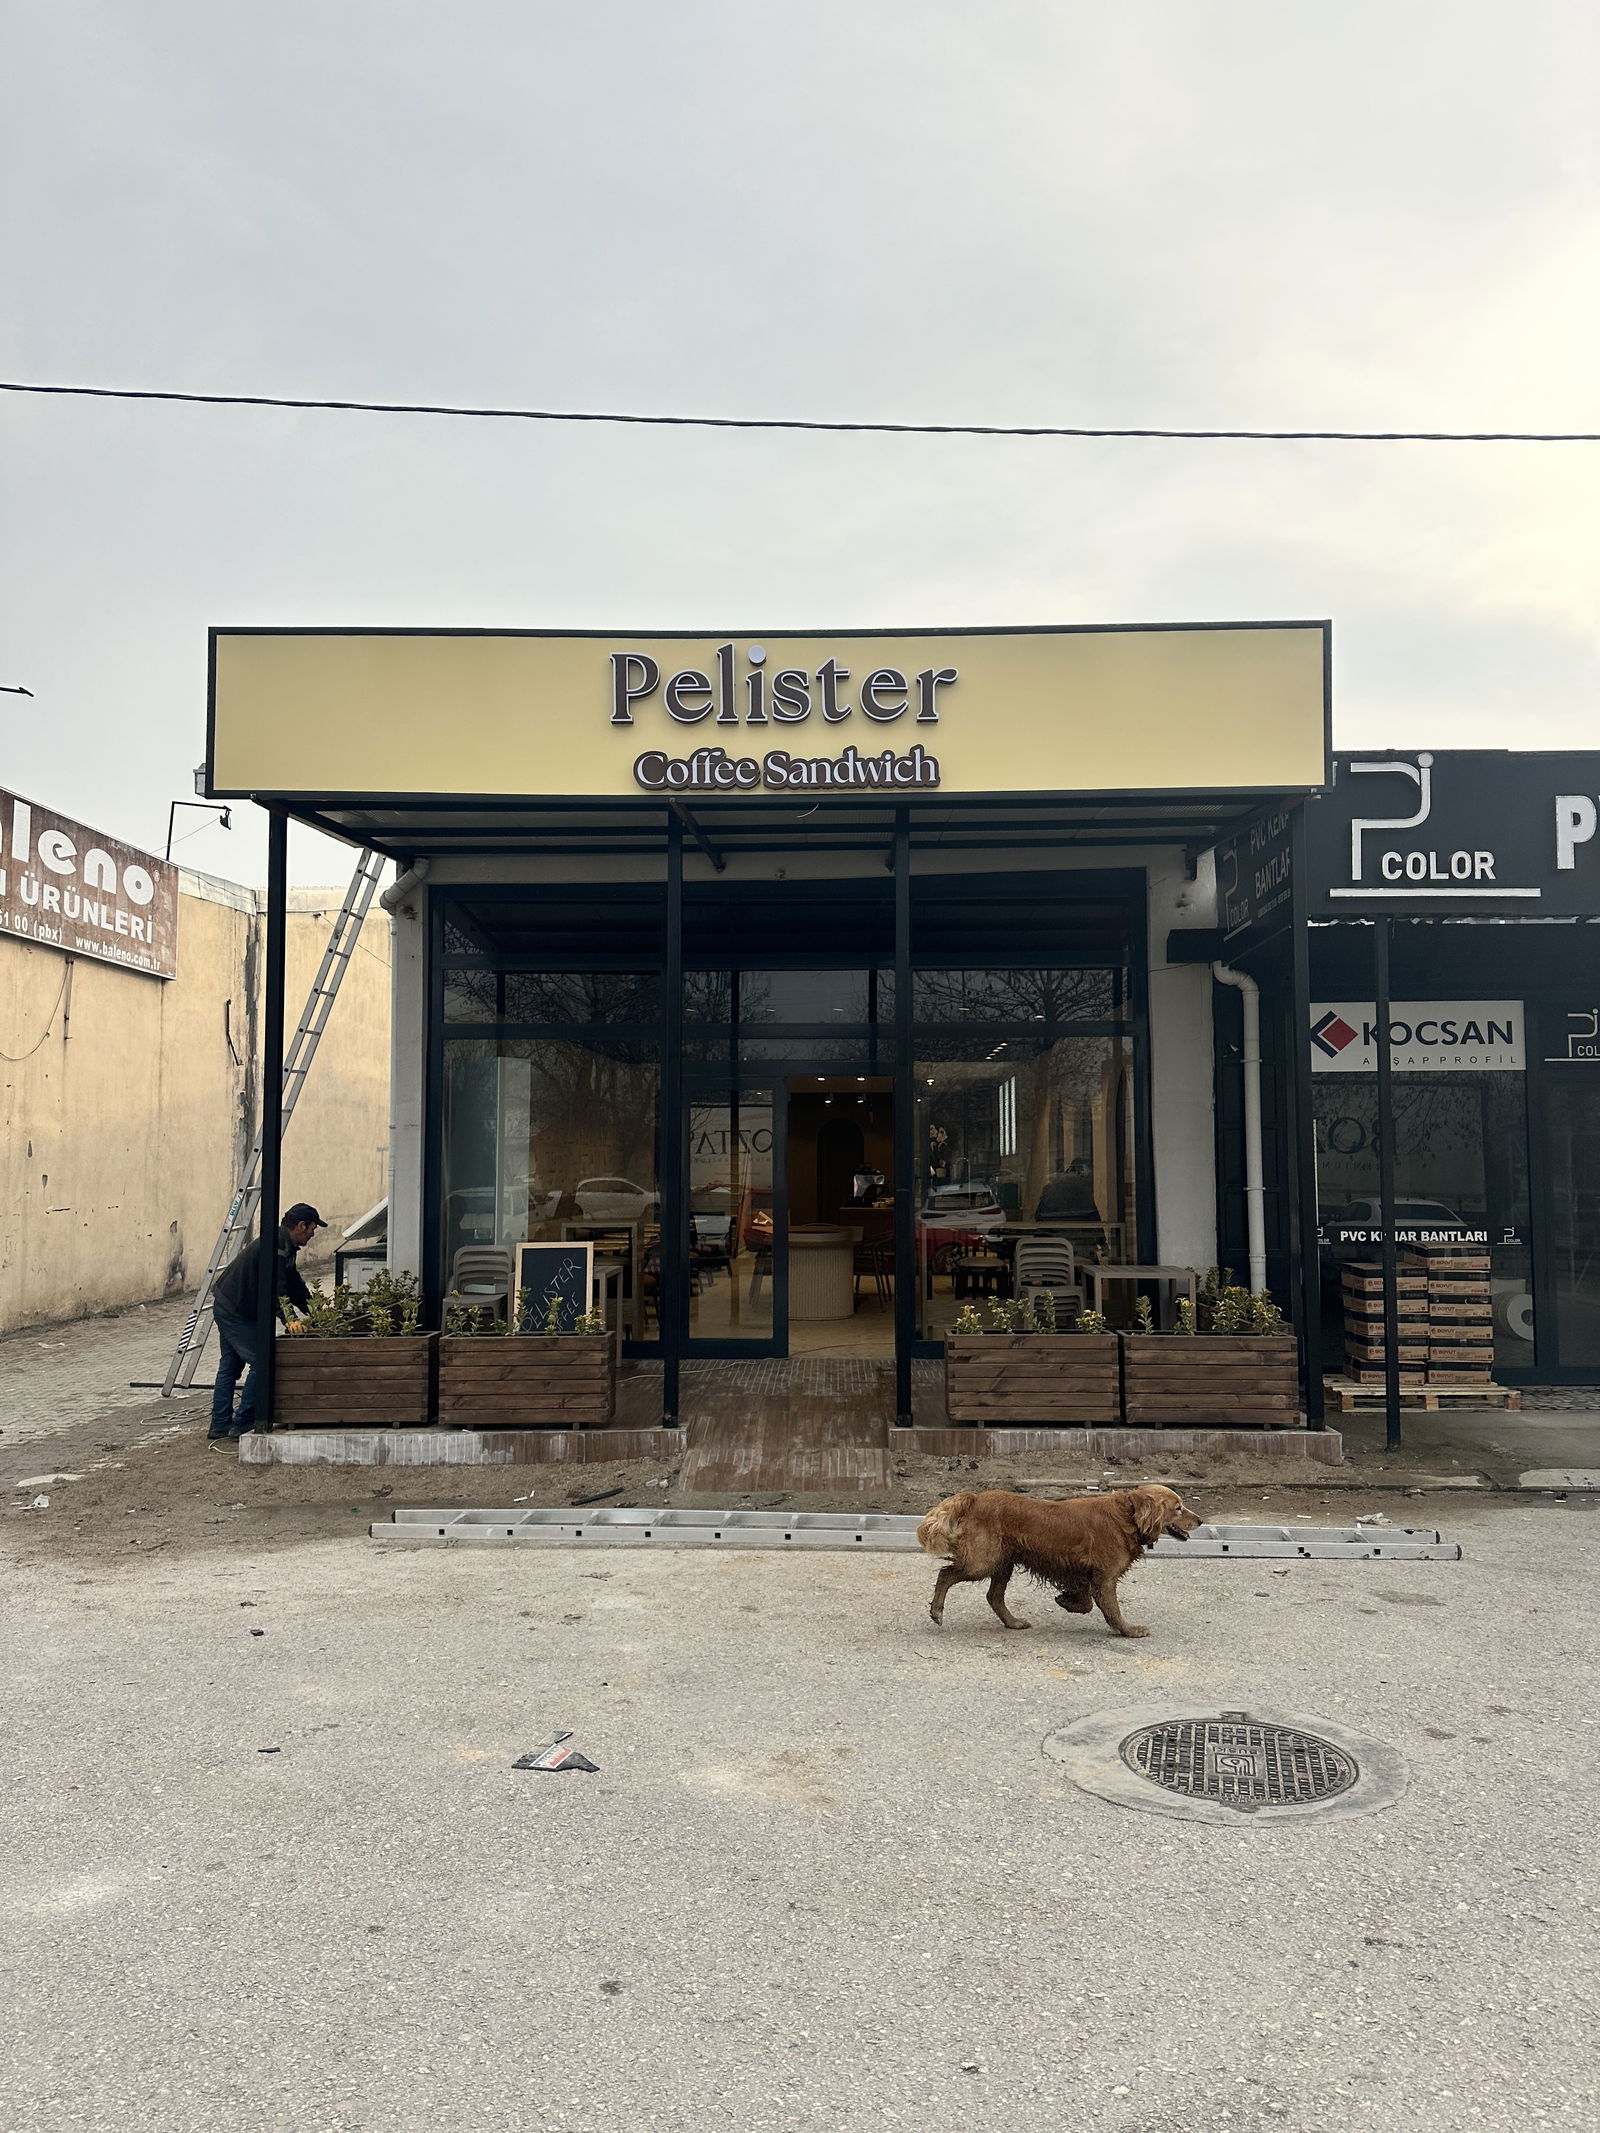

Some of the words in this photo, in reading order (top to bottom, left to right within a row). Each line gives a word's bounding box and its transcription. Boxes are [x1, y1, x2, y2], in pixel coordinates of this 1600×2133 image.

[610, 642, 959, 725] Pelister
[635, 748, 760, 788] Coffee
[764, 746, 940, 788] Sandwich
[1555, 795, 1600, 870] P
[0, 799, 155, 906] leno
[1381, 850, 1497, 881] COLOR
[20, 870, 154, 945] ÜRÜNLERİ
[1230, 898, 1249, 928] COLOR
[14, 917, 28, 932] 00
[33, 919, 63, 945] (pbx)
[75, 935, 161, 971] www.baleno.com.tr
[1362, 1020, 1514, 1046] KOCSAN
[1362, 1055, 1430, 1067] AŞAP
[1340, 1231, 1367, 1242] PVC
[1370, 1231, 1417, 1242] KAR
[1420, 1231, 1488, 1242] BANTLARI
